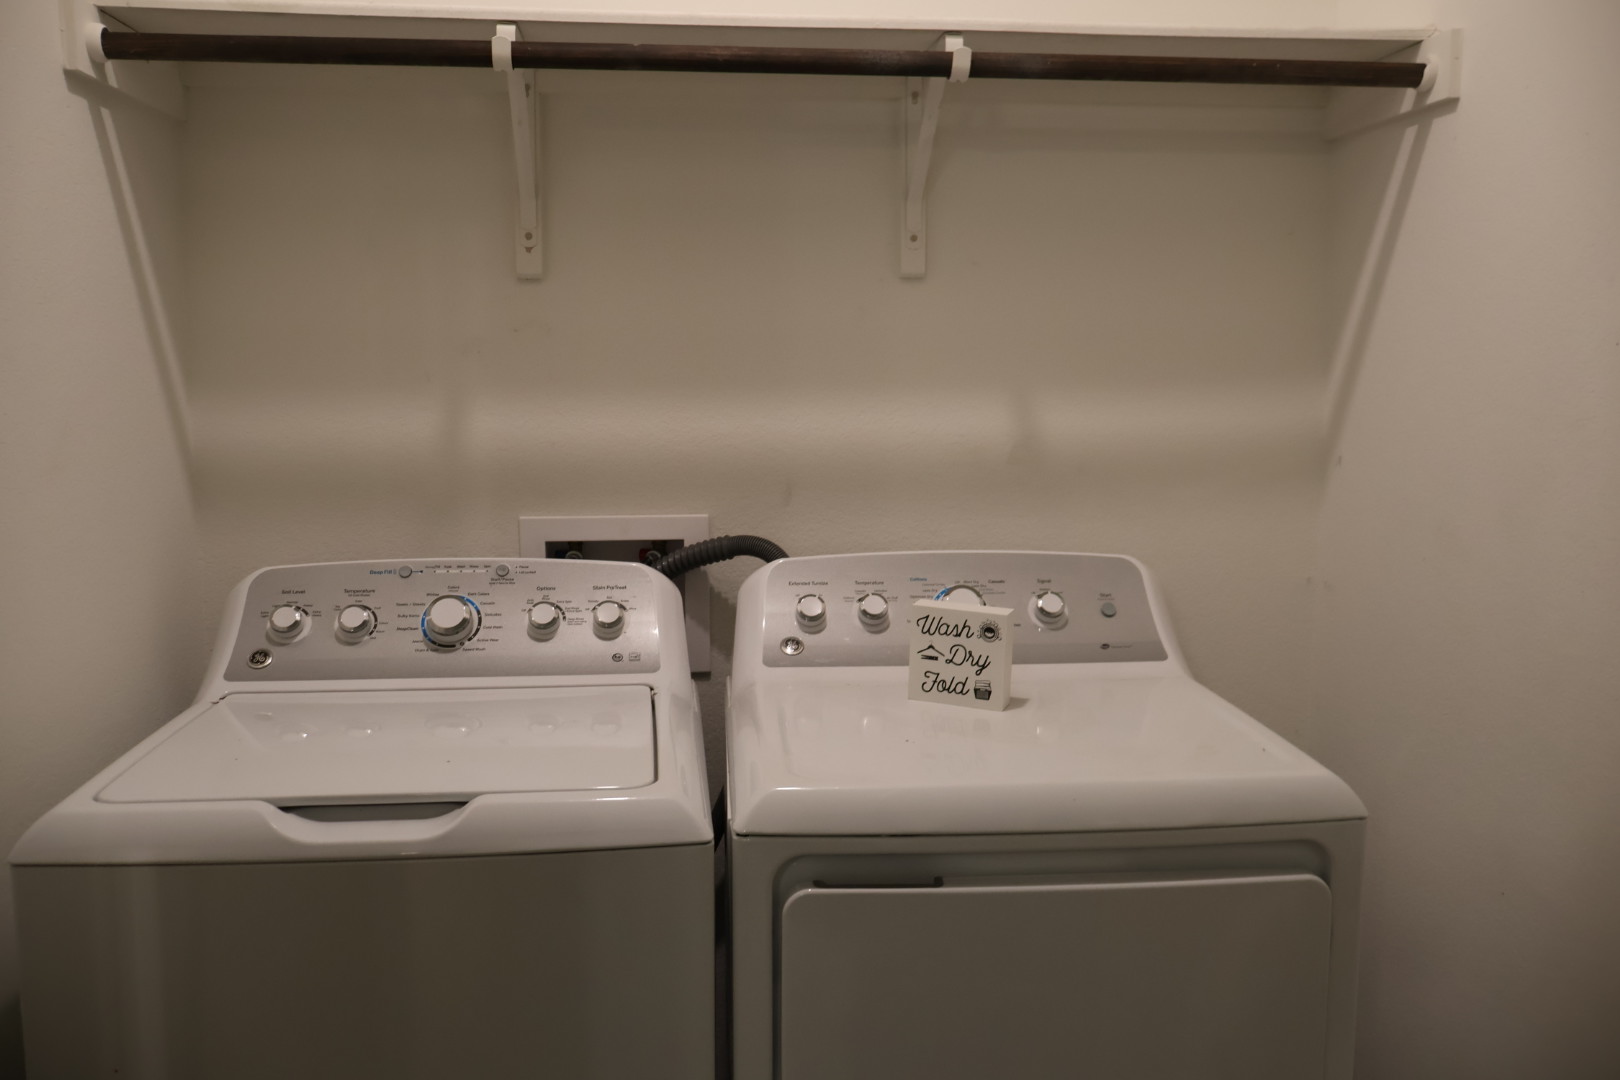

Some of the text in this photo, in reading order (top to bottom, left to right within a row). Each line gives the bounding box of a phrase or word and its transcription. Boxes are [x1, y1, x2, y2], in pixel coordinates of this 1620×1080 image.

[916, 614, 975, 639] Wash
[945, 644, 991, 676] Dry
[921, 670, 970, 696] Fold
